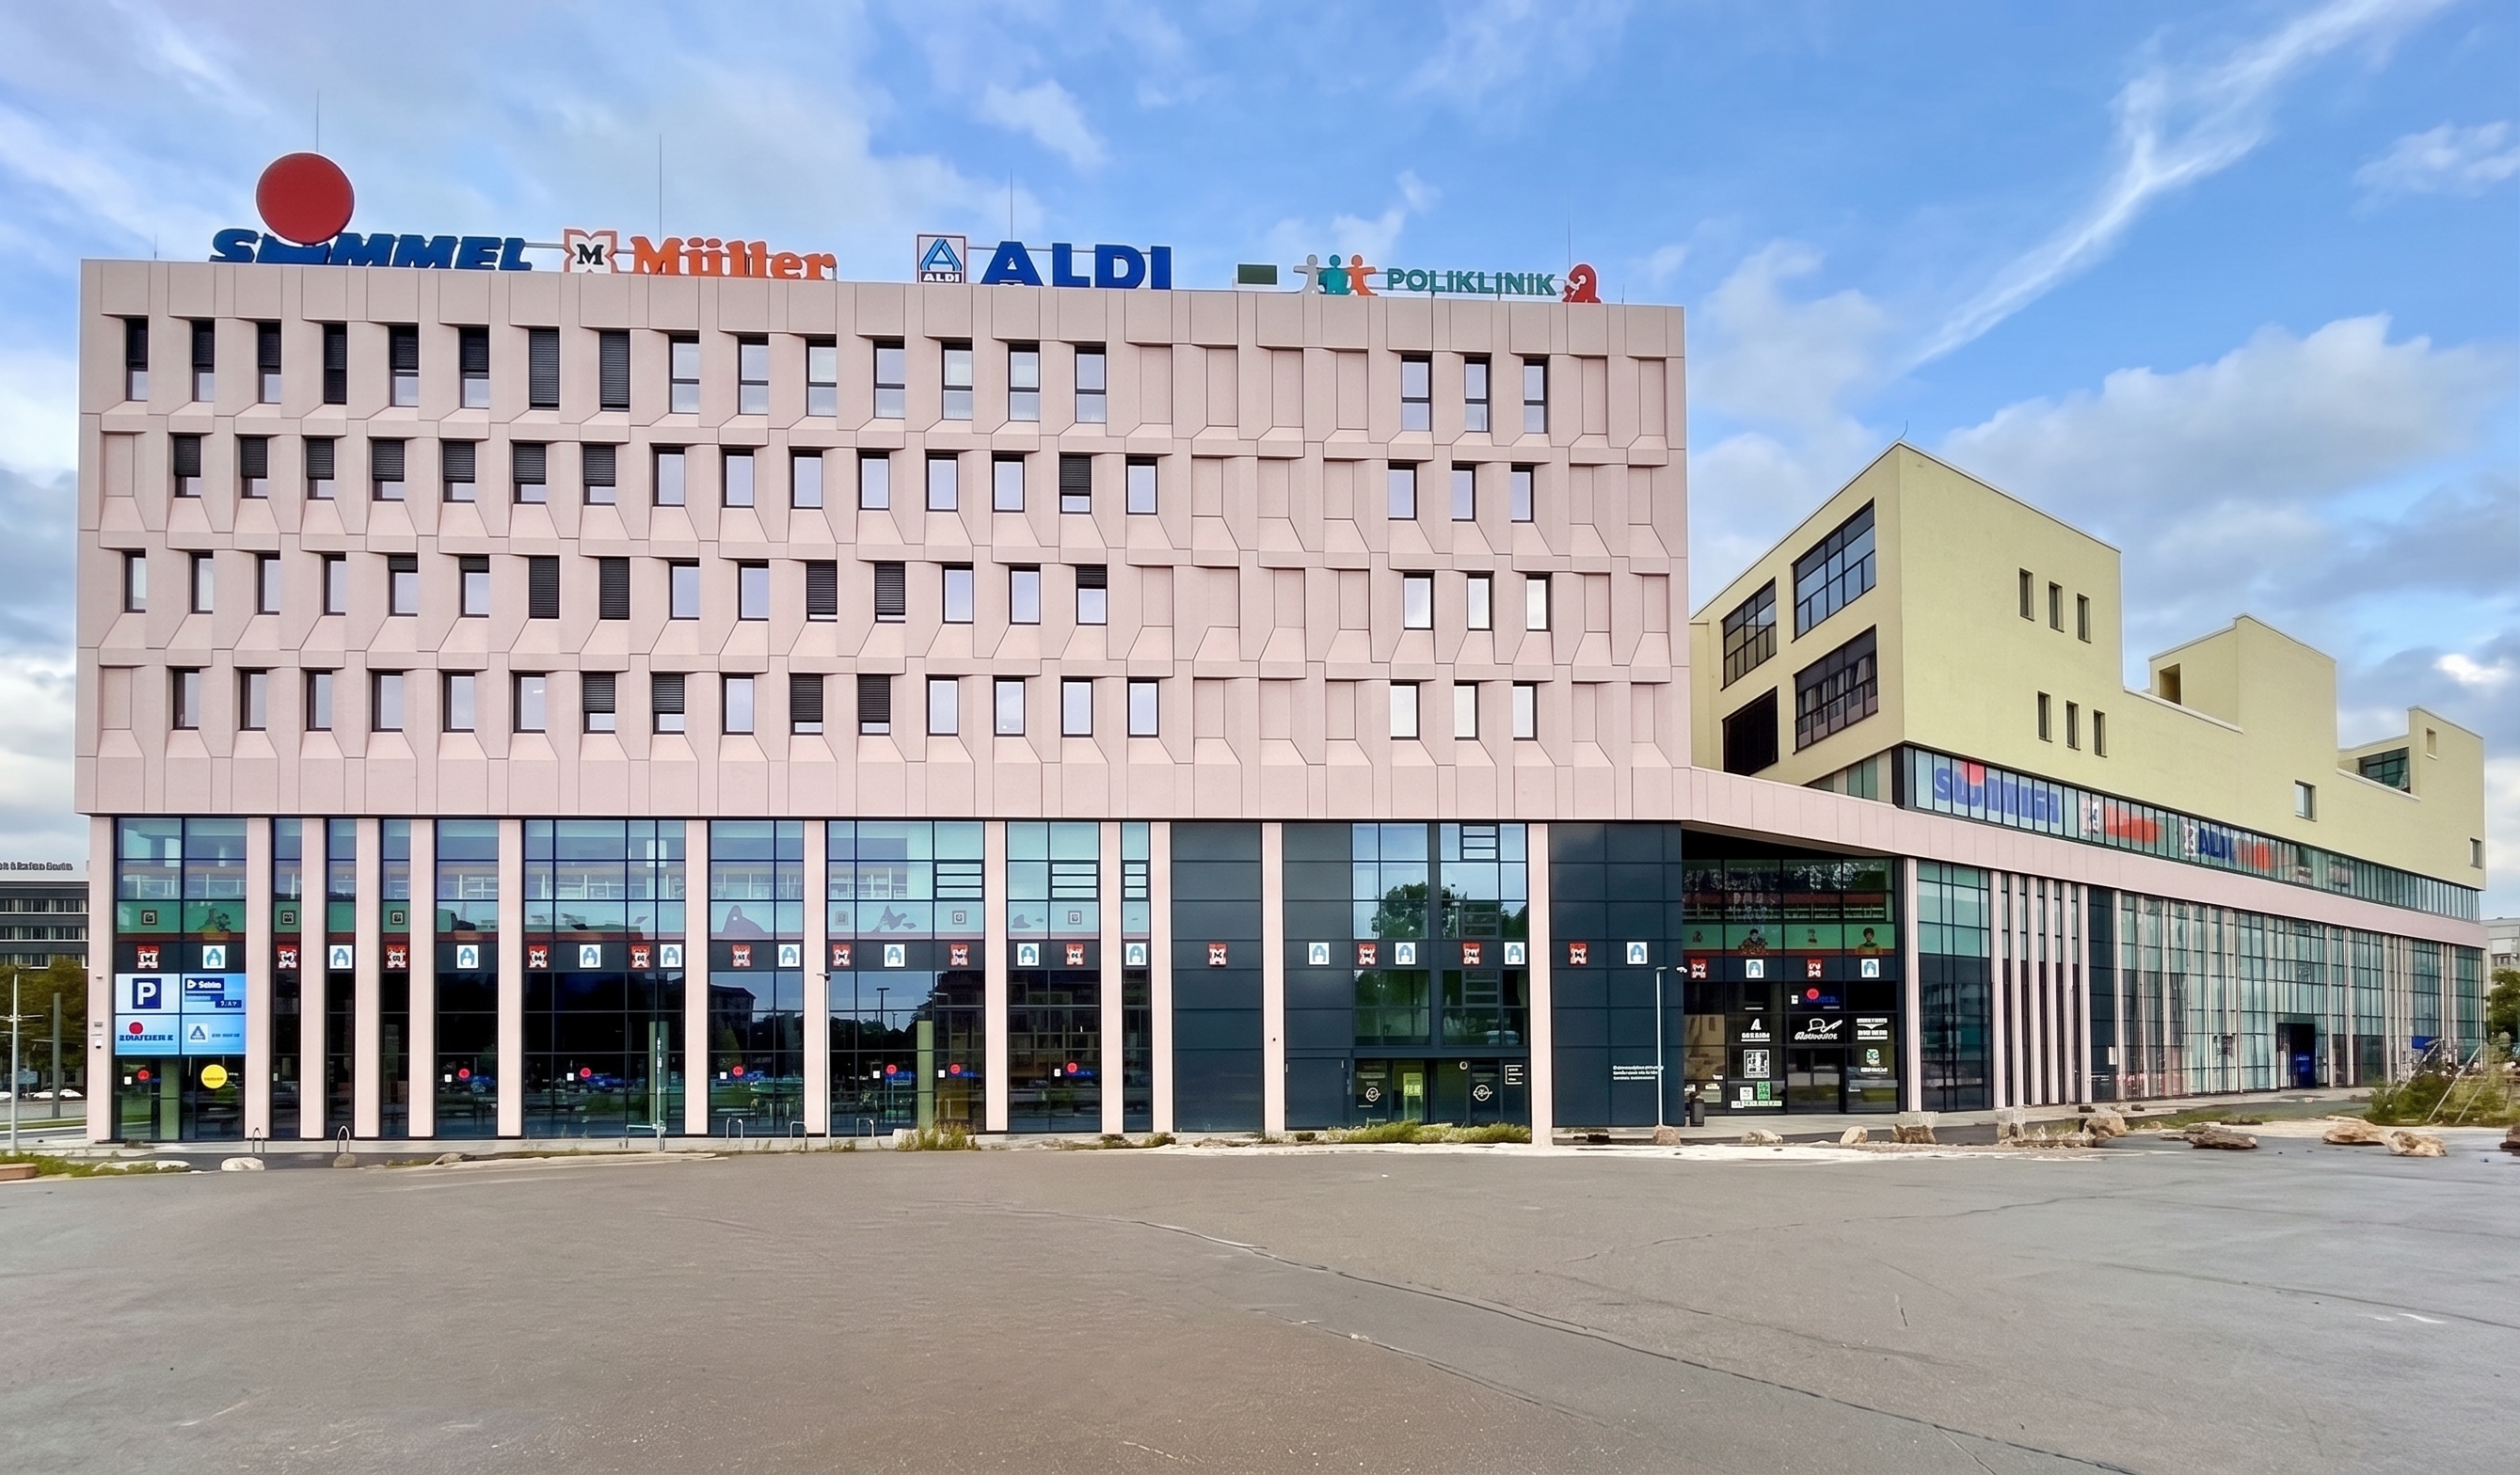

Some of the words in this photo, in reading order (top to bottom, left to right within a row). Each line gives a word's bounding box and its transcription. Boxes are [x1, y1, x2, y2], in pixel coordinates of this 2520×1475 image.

[630, 236, 837, 280] Müller
[980, 241, 1172, 290] ALDI
[923, 273, 960, 282] ALDI
[1387, 268, 1557, 296] POLIKLINIK
[137, 981, 157, 1006] P
